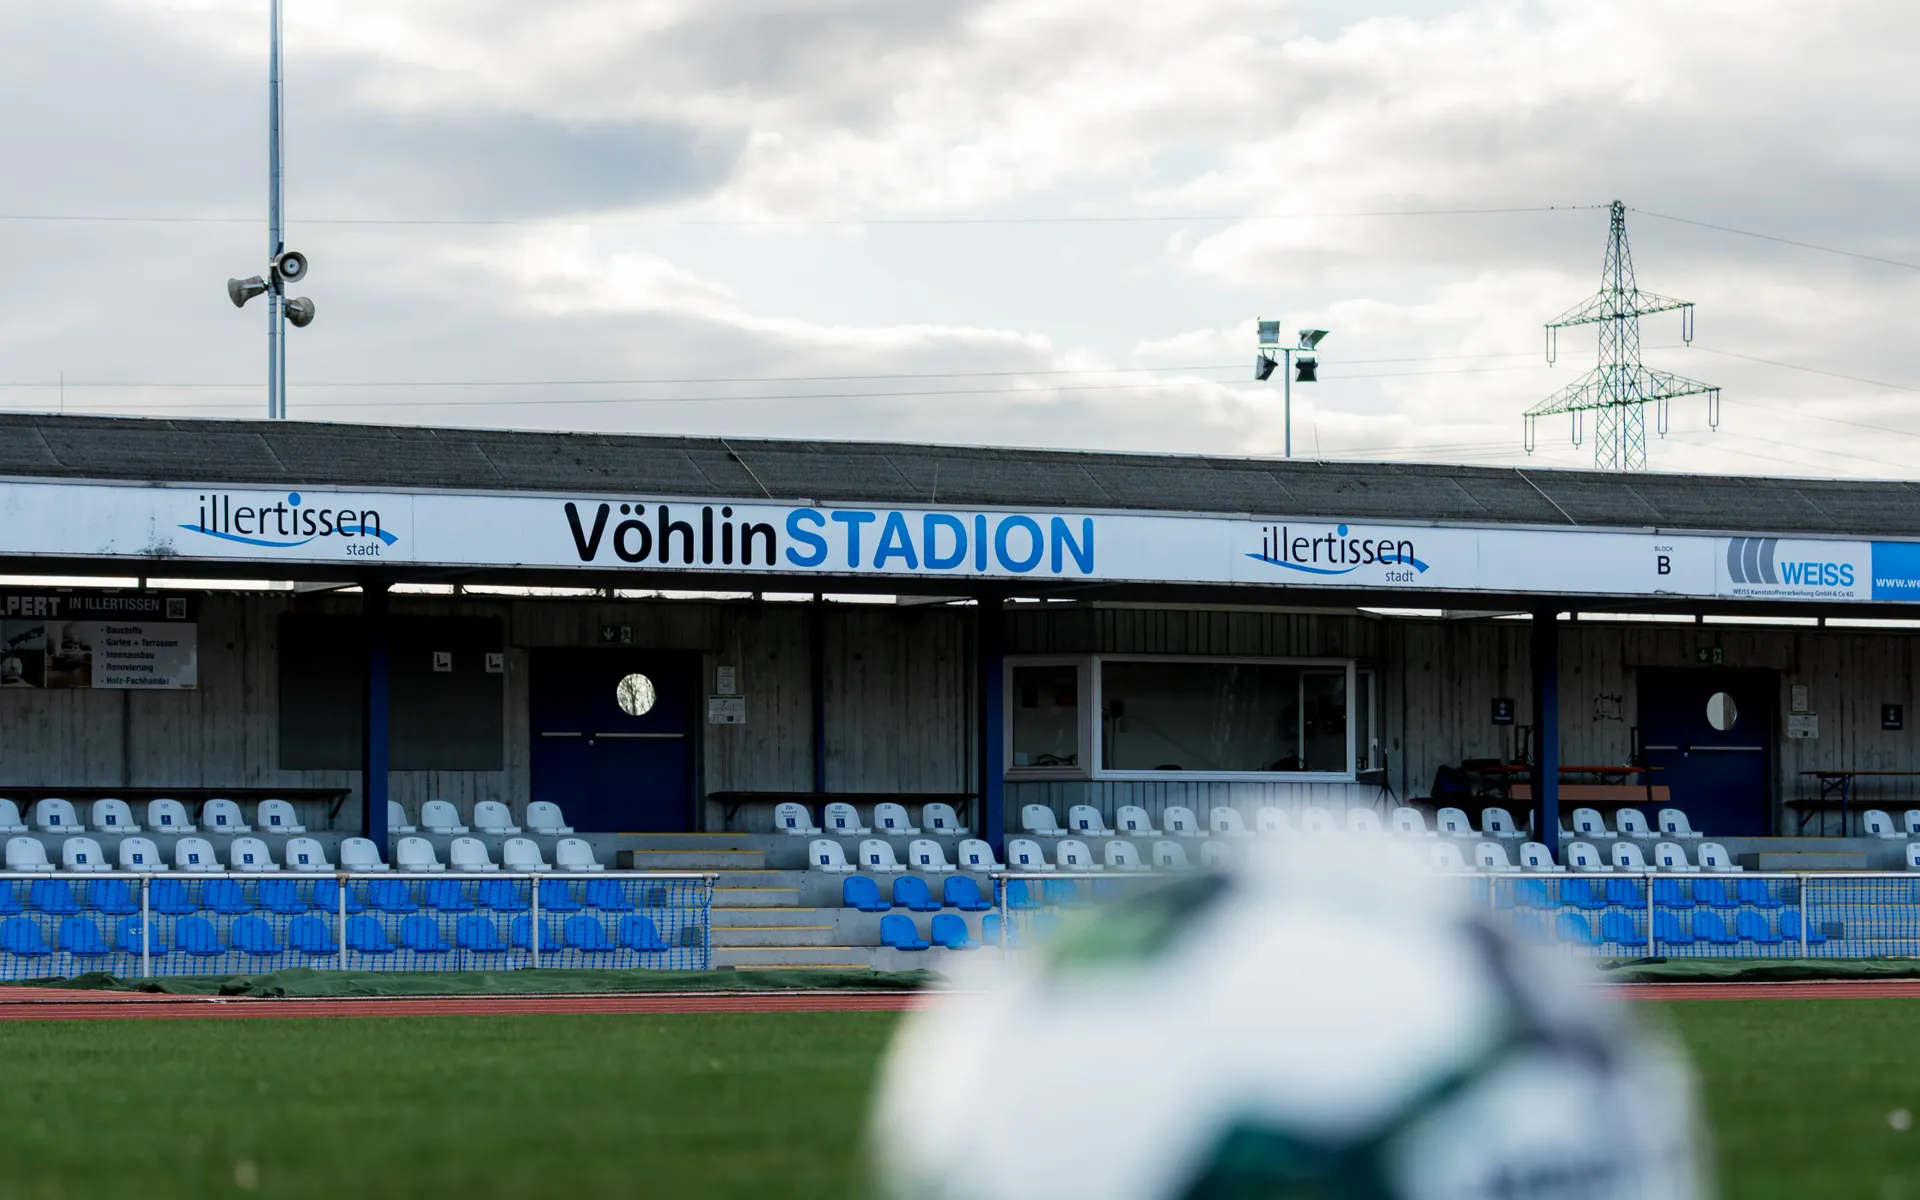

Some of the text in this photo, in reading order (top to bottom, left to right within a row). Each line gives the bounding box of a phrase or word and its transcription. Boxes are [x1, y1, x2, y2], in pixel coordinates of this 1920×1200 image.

[200, 492, 381, 537] illertissen
[564, 501, 1094, 575] VöhlinSTADION
[1263, 524, 1415, 565] illertissen
[346, 542, 380, 556] stadt
[1657, 555, 1671, 575] B
[1385, 569, 1414, 583] stadt
[1780, 561, 1855, 587] WEISS
[69, 597, 82, 610] IN
[85, 597, 160, 612] ILLERTISSEN
[106, 626, 143, 635] Baustoffe
[141, 638, 178, 647] Terrassen
[106, 651, 155, 660] Innenausbau
[106, 663, 154, 673] Renovierung
[106, 677, 170, 685] Holz-Fachhandel
